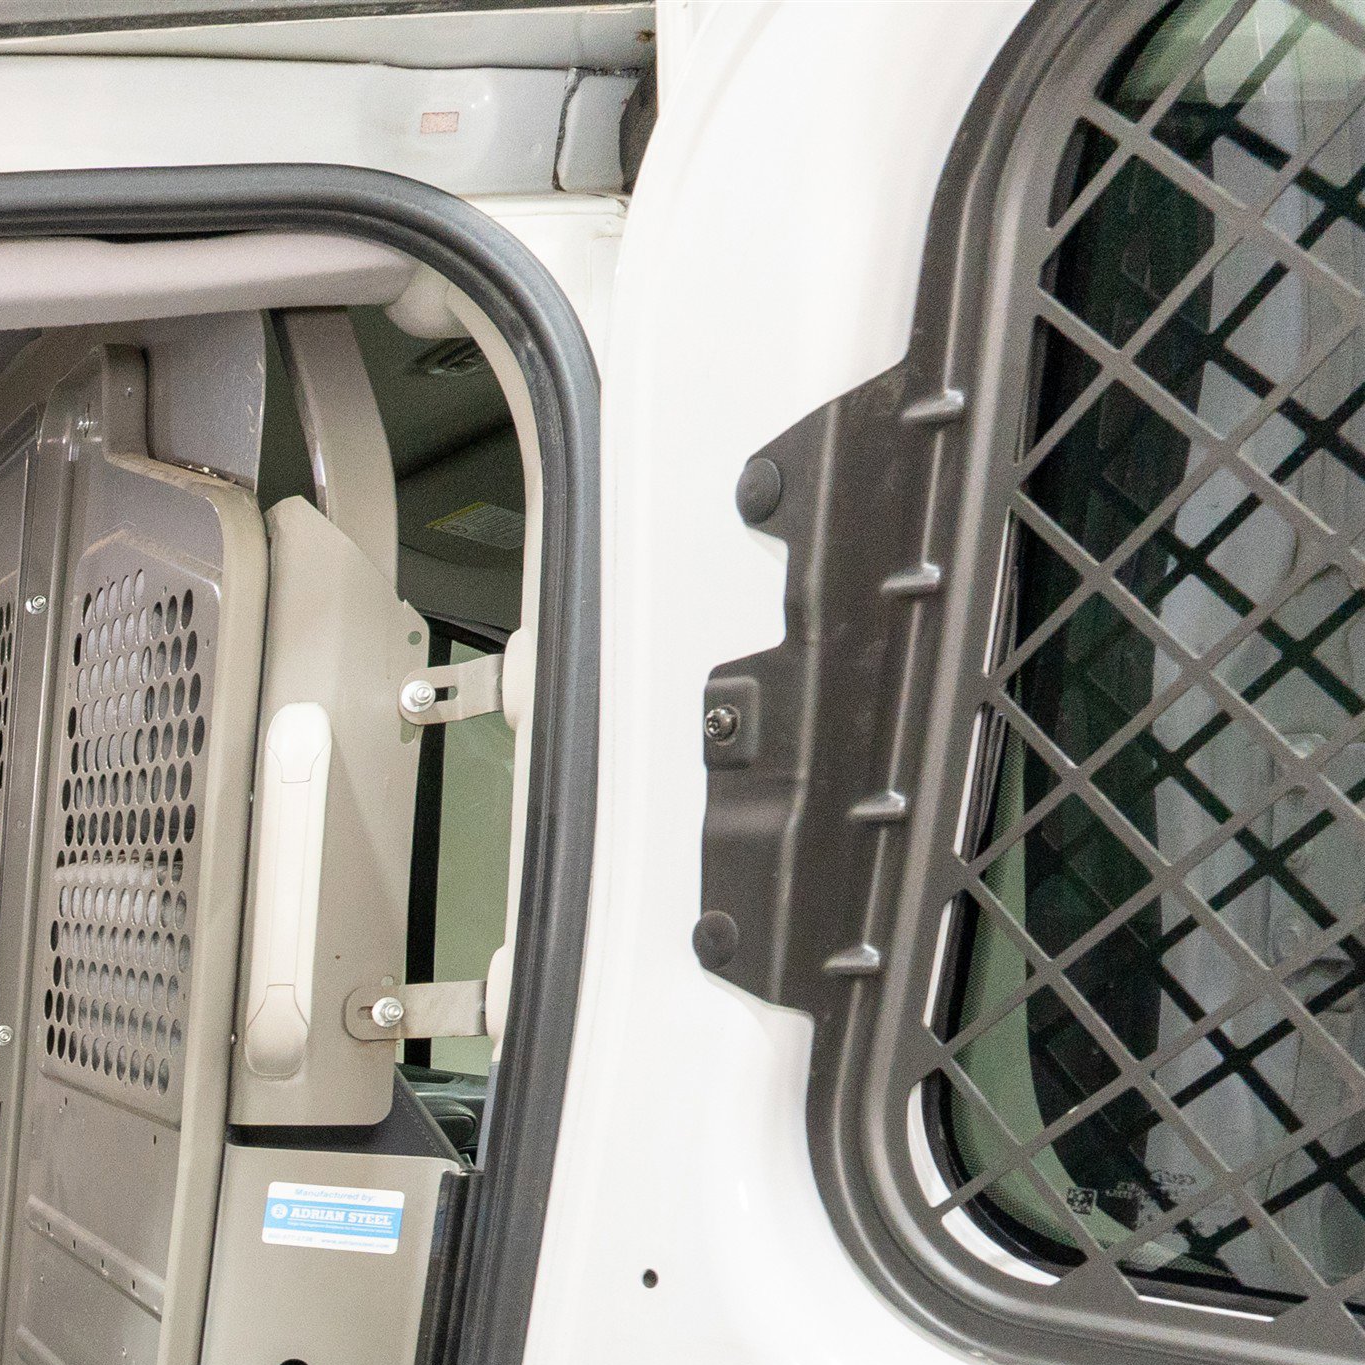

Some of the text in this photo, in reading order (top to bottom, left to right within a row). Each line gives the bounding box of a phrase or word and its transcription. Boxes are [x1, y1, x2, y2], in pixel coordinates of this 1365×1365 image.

[295, 1188, 359, 1201] Manufactured
[290, 1207, 392, 1226] ADRIAN STEEL
